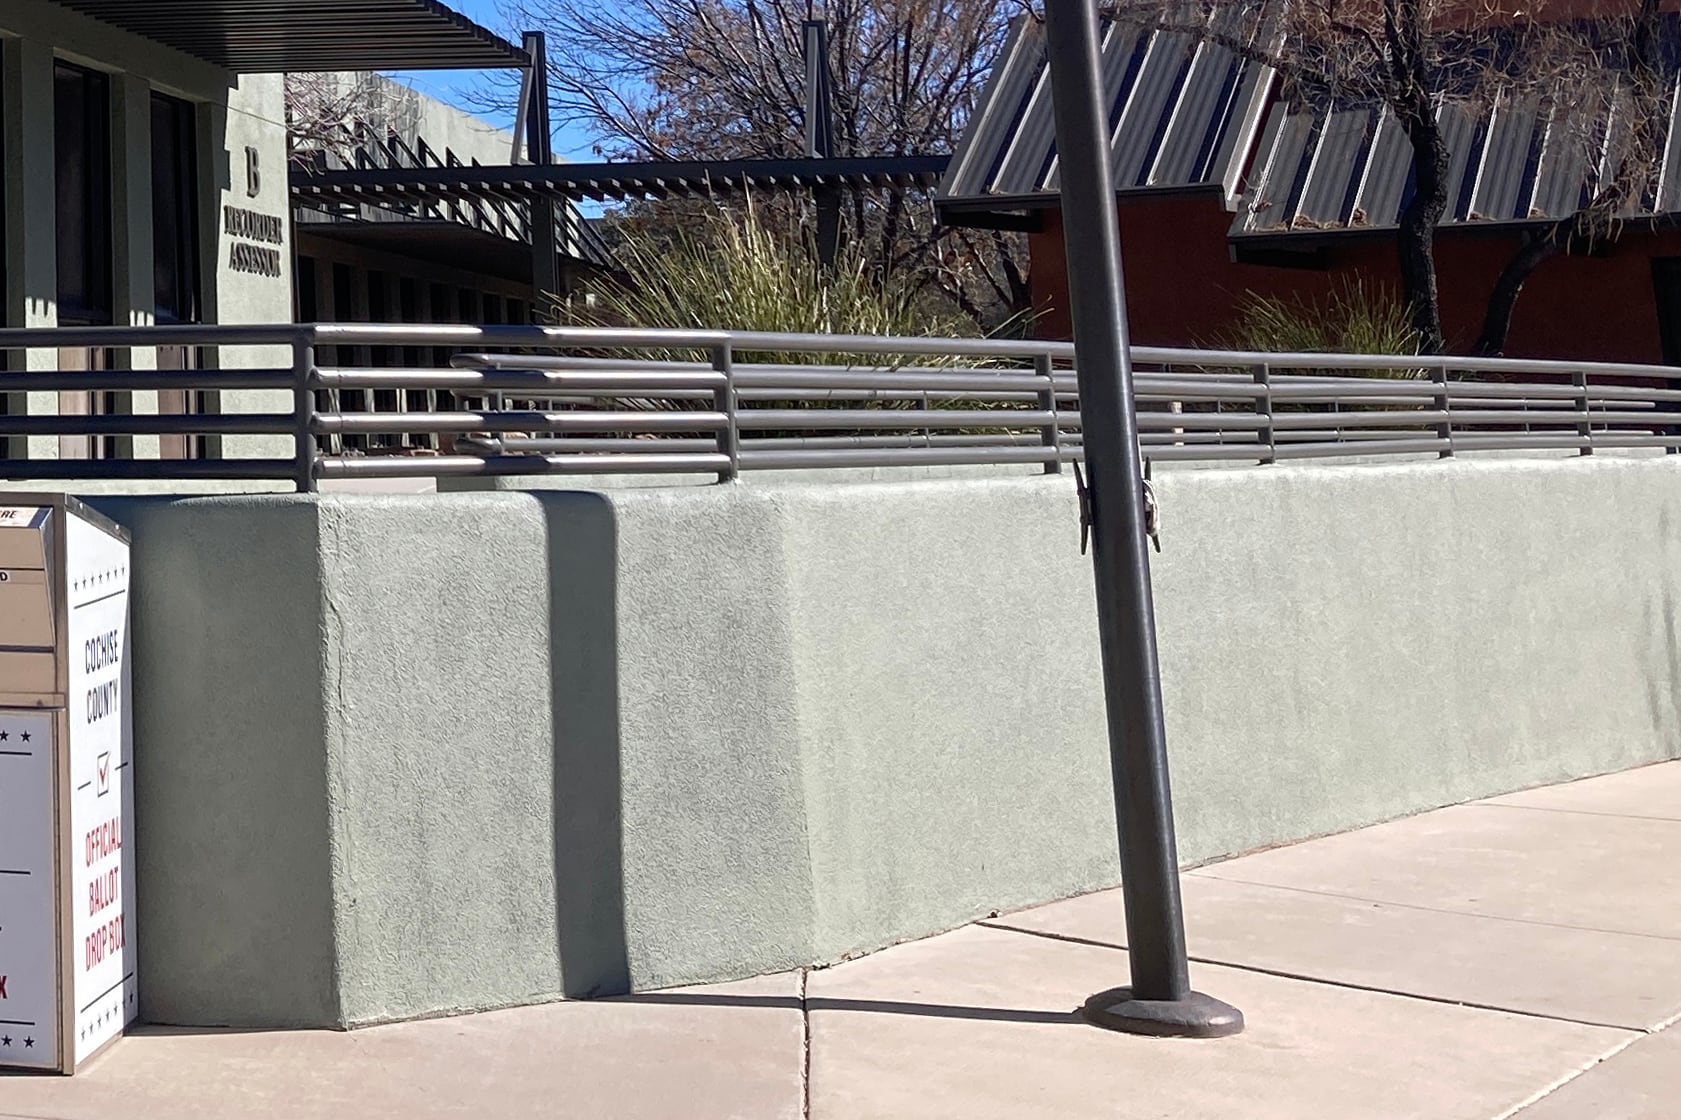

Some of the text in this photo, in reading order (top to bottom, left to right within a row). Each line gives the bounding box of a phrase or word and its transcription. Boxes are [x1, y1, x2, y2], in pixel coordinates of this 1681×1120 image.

[244, 145, 261, 198] B
[224, 205, 283, 246] RECORDER
[228, 241, 281, 278] ASSESSOR
[84, 629, 118, 675] COCHISE
[86, 678, 118, 725] COUNTY
[85, 815, 122, 868] OFFICIAL
[89, 866, 119, 918] BALLOT
[85, 912, 126, 972] DROP BOX
